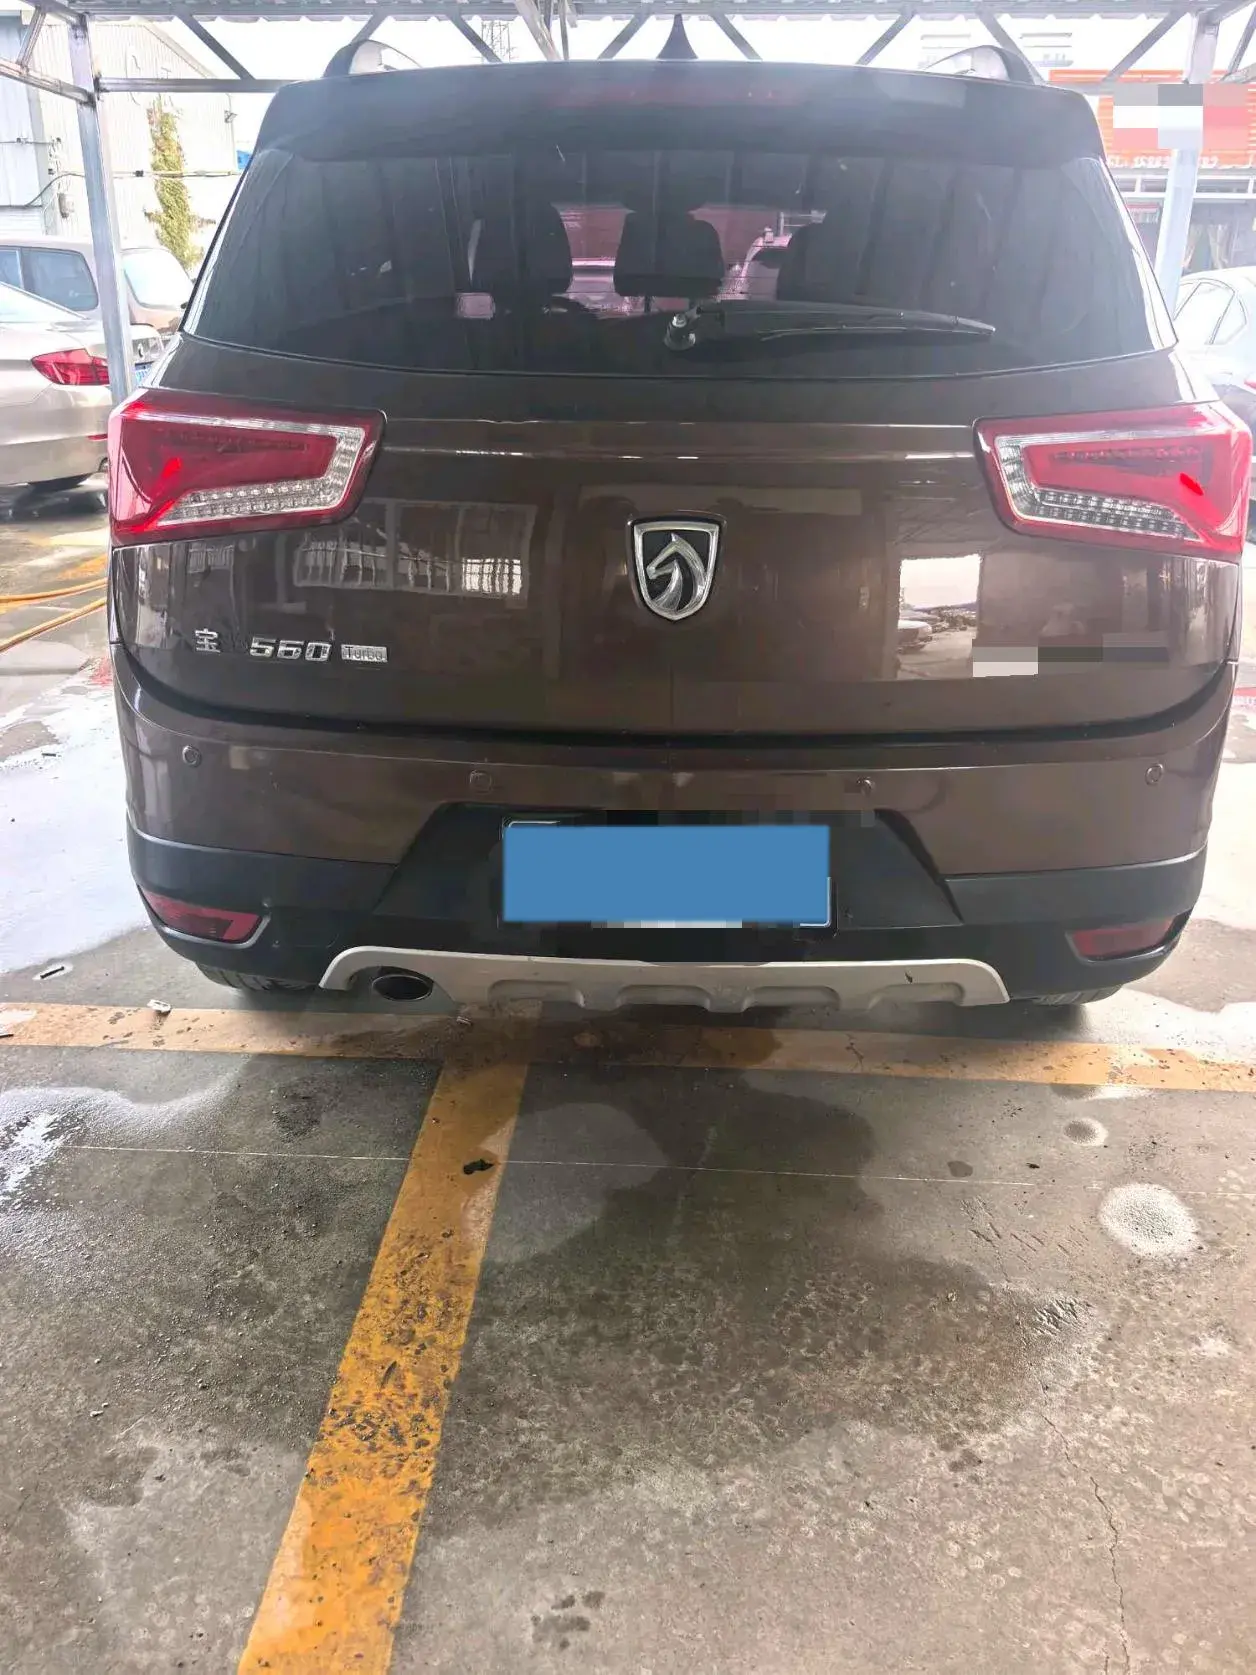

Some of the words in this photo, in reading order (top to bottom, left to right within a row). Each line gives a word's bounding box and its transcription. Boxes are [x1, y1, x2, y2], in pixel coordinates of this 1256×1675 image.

[194, 628, 220, 653] 宝
[250, 637, 332, 662] 560
[342, 645, 386, 662] Turbo
